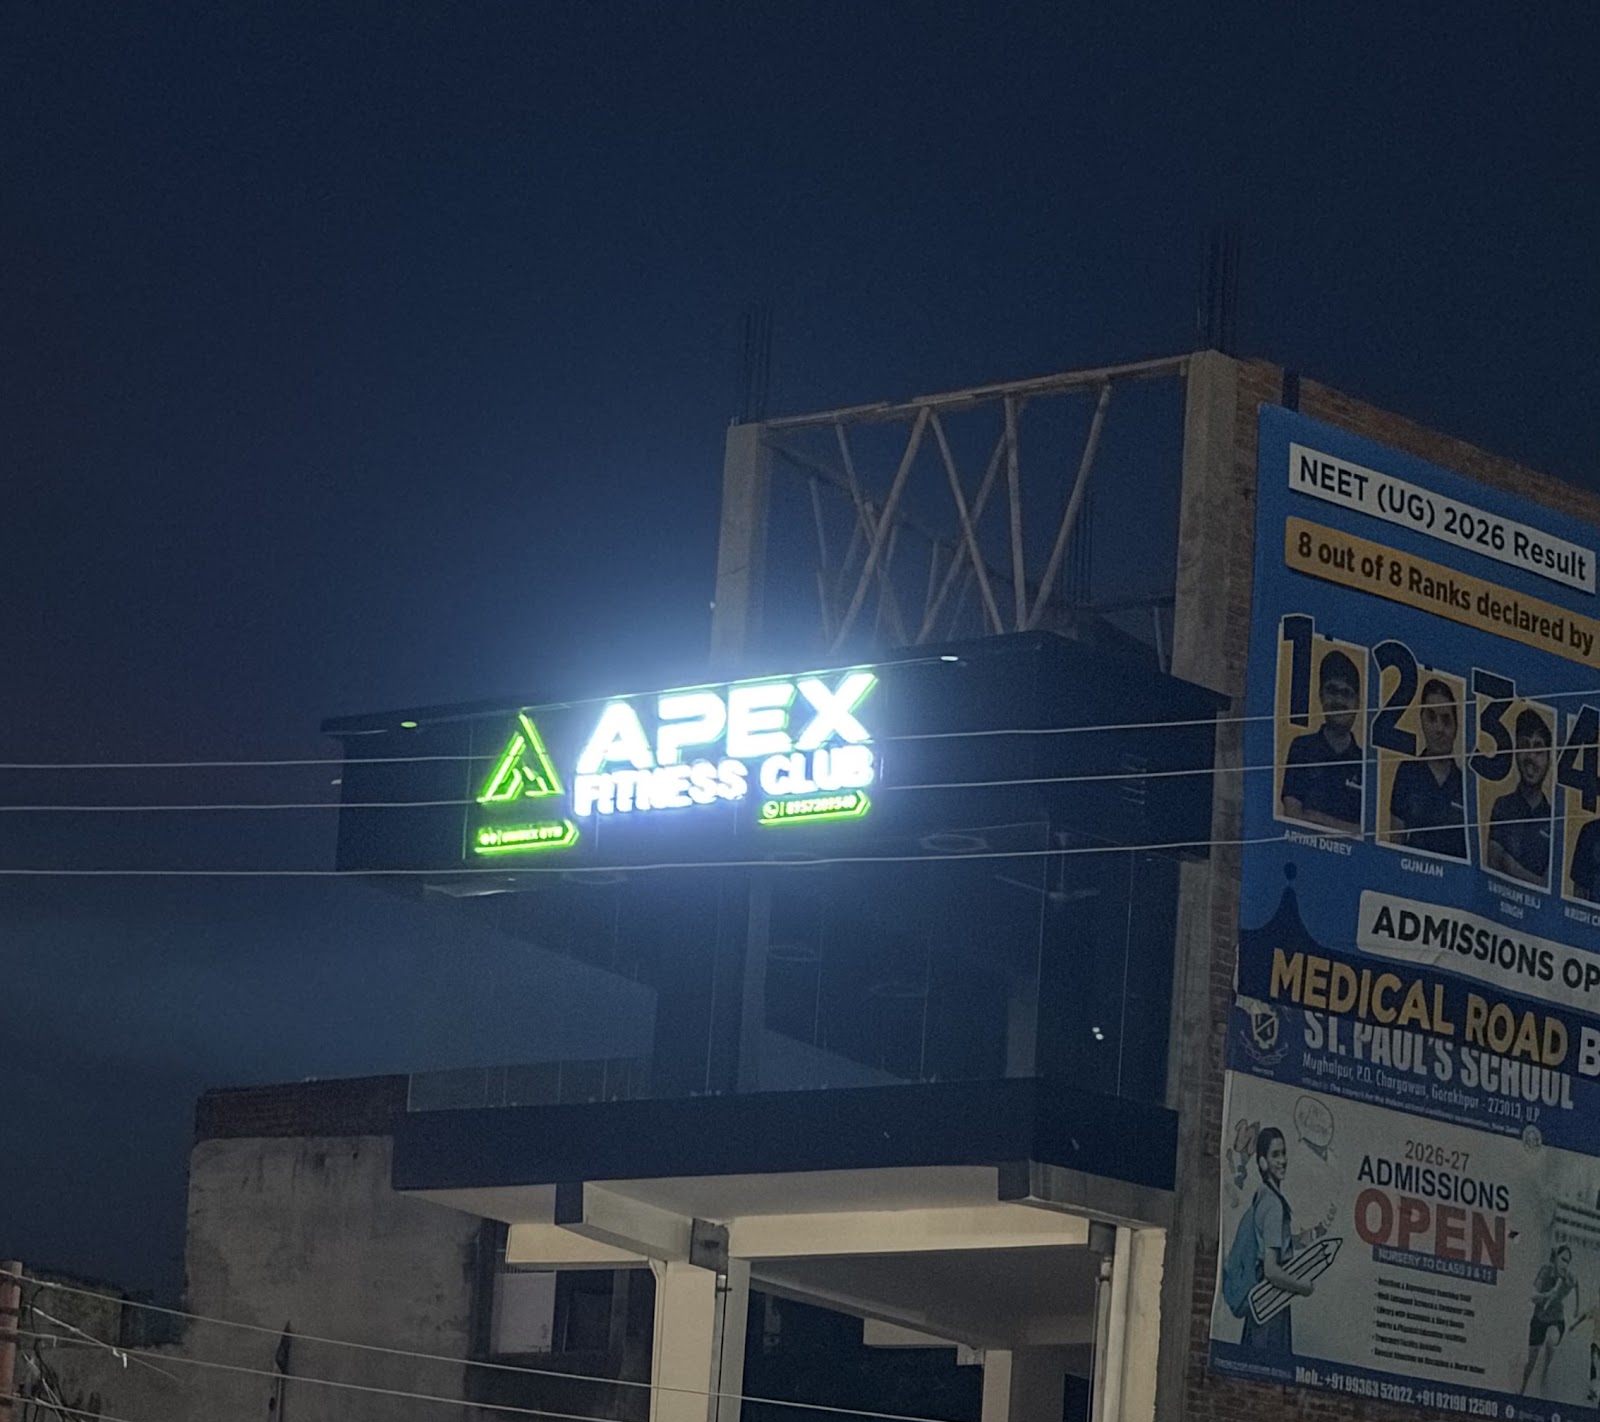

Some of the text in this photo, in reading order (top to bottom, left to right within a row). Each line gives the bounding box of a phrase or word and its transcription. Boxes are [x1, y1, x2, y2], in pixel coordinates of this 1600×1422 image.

[1300, 455, 1587, 581] NEET (UG) 2026 Result
[1298, 531, 1594, 656] 8 out of 8 Ranks declared by
[577, 672, 879, 774] APEX
[1282, 613, 1600, 814] 1 2 3 4
[574, 744, 875, 816] FITNESS CLUB
[1400, 857, 1444, 878] GUNJAN
[1372, 905, 1555, 983] ADMISSIONS
[1271, 947, 1455, 1035] MEDICAL
[1465, 992, 1569, 1067] ROAD
[1353, 1021, 1454, 1081] PAUL'S
[1460, 1046, 1574, 1110] SCHOOL
[1357, 1155, 1510, 1212] ADMISSIONS
[1404, 1140, 1470, 1172] 2026-27
[1354, 1188, 1506, 1271] OPEN
[1378, 1248, 1421, 1267] NURSERY
[1422, 1257, 1435, 1269] TO
[1436, 1259, 1465, 1275] CLASS
[1324, 1372, 1344, 1391] +91
